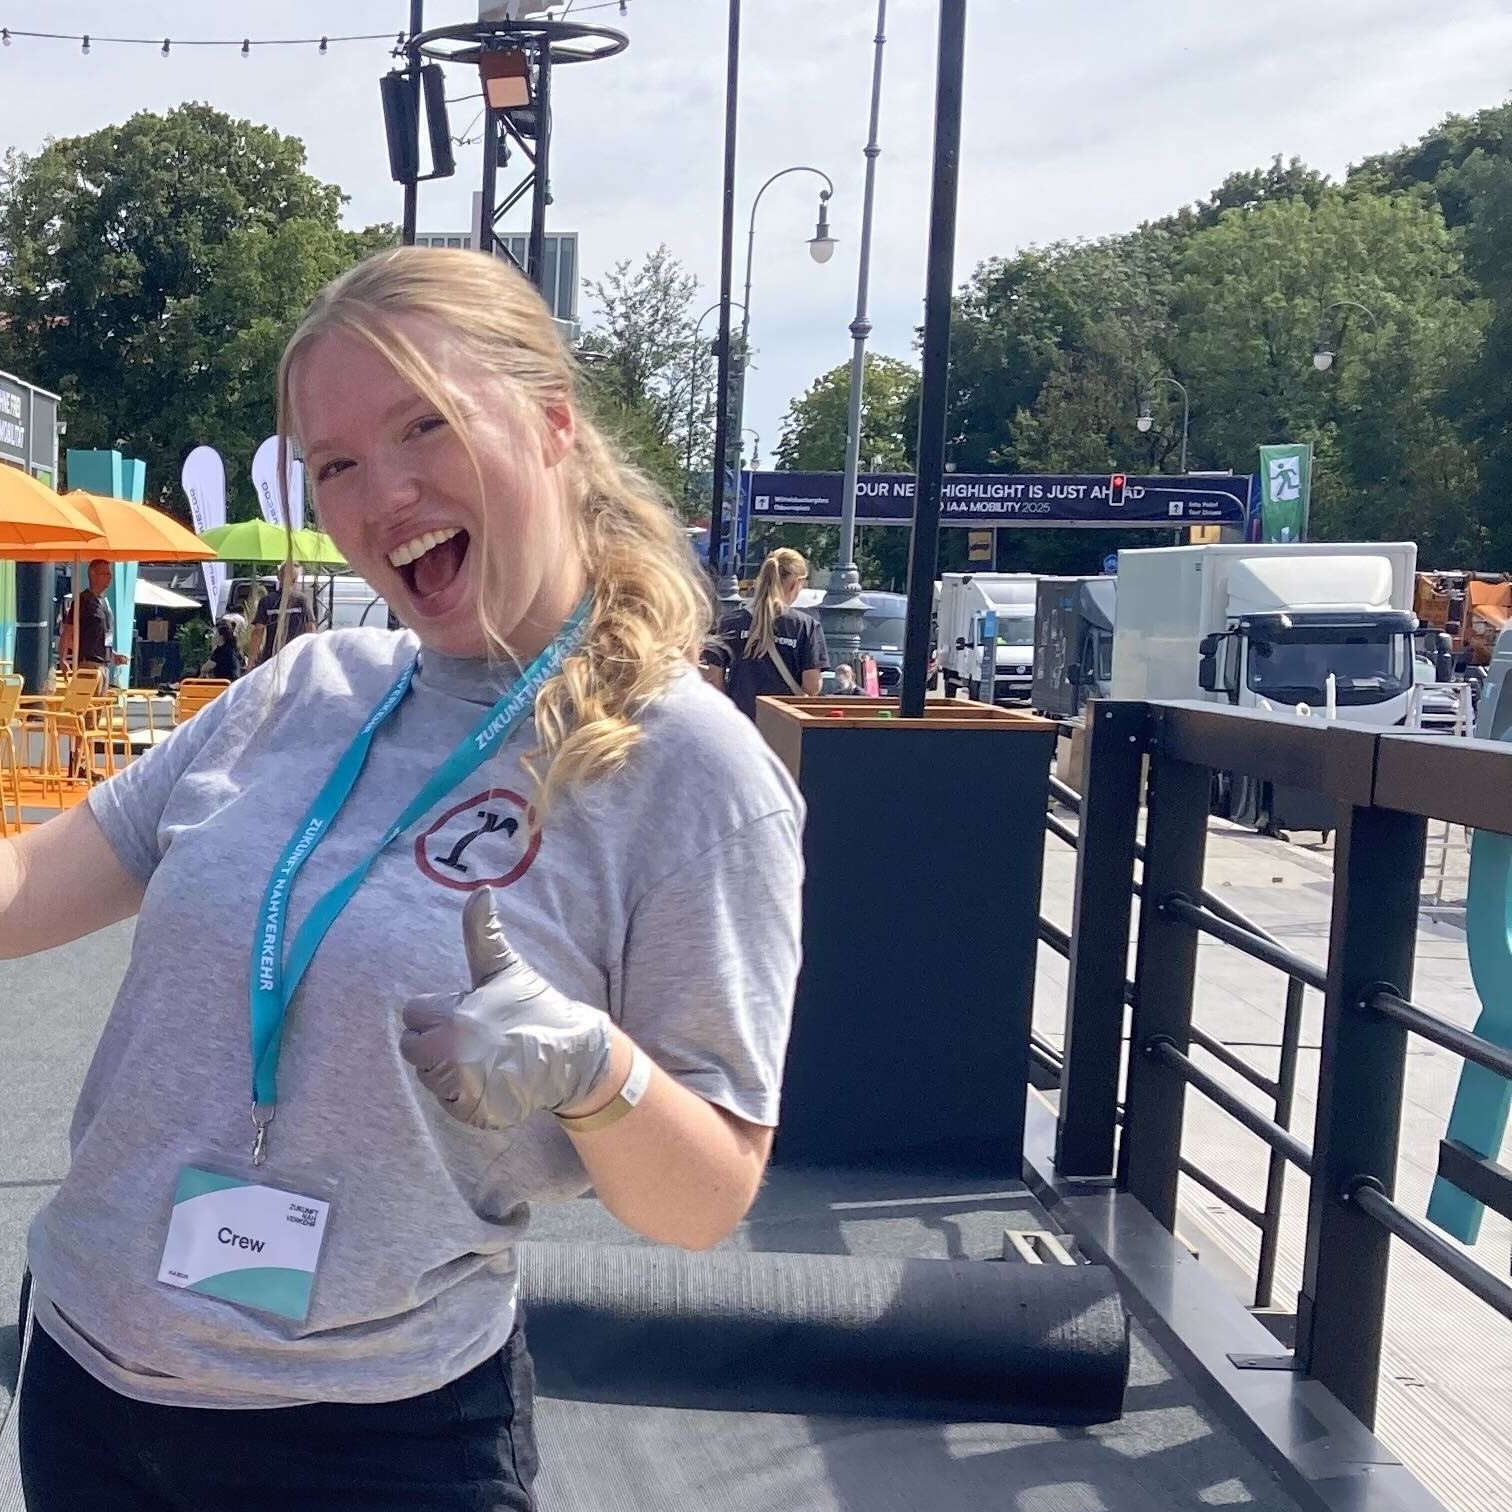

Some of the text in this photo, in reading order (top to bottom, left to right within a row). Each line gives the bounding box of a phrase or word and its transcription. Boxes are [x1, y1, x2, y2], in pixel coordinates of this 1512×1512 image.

[893, 483, 915, 497] NE
[941, 484, 1025, 498] HIGHLIGHT
[1028, 484, 1043, 498] IS
[1047, 485, 1087, 499] JUST
[1090, 485, 1146, 499] AHAD
[947, 501, 1051, 513] IAA MOBILITY 2025
[475, 681, 534, 750] ZUKUNFT
[259, 817, 323, 992] ZUKUNFT NAHVERKEHR
[217, 1226, 265, 1253] Crew
